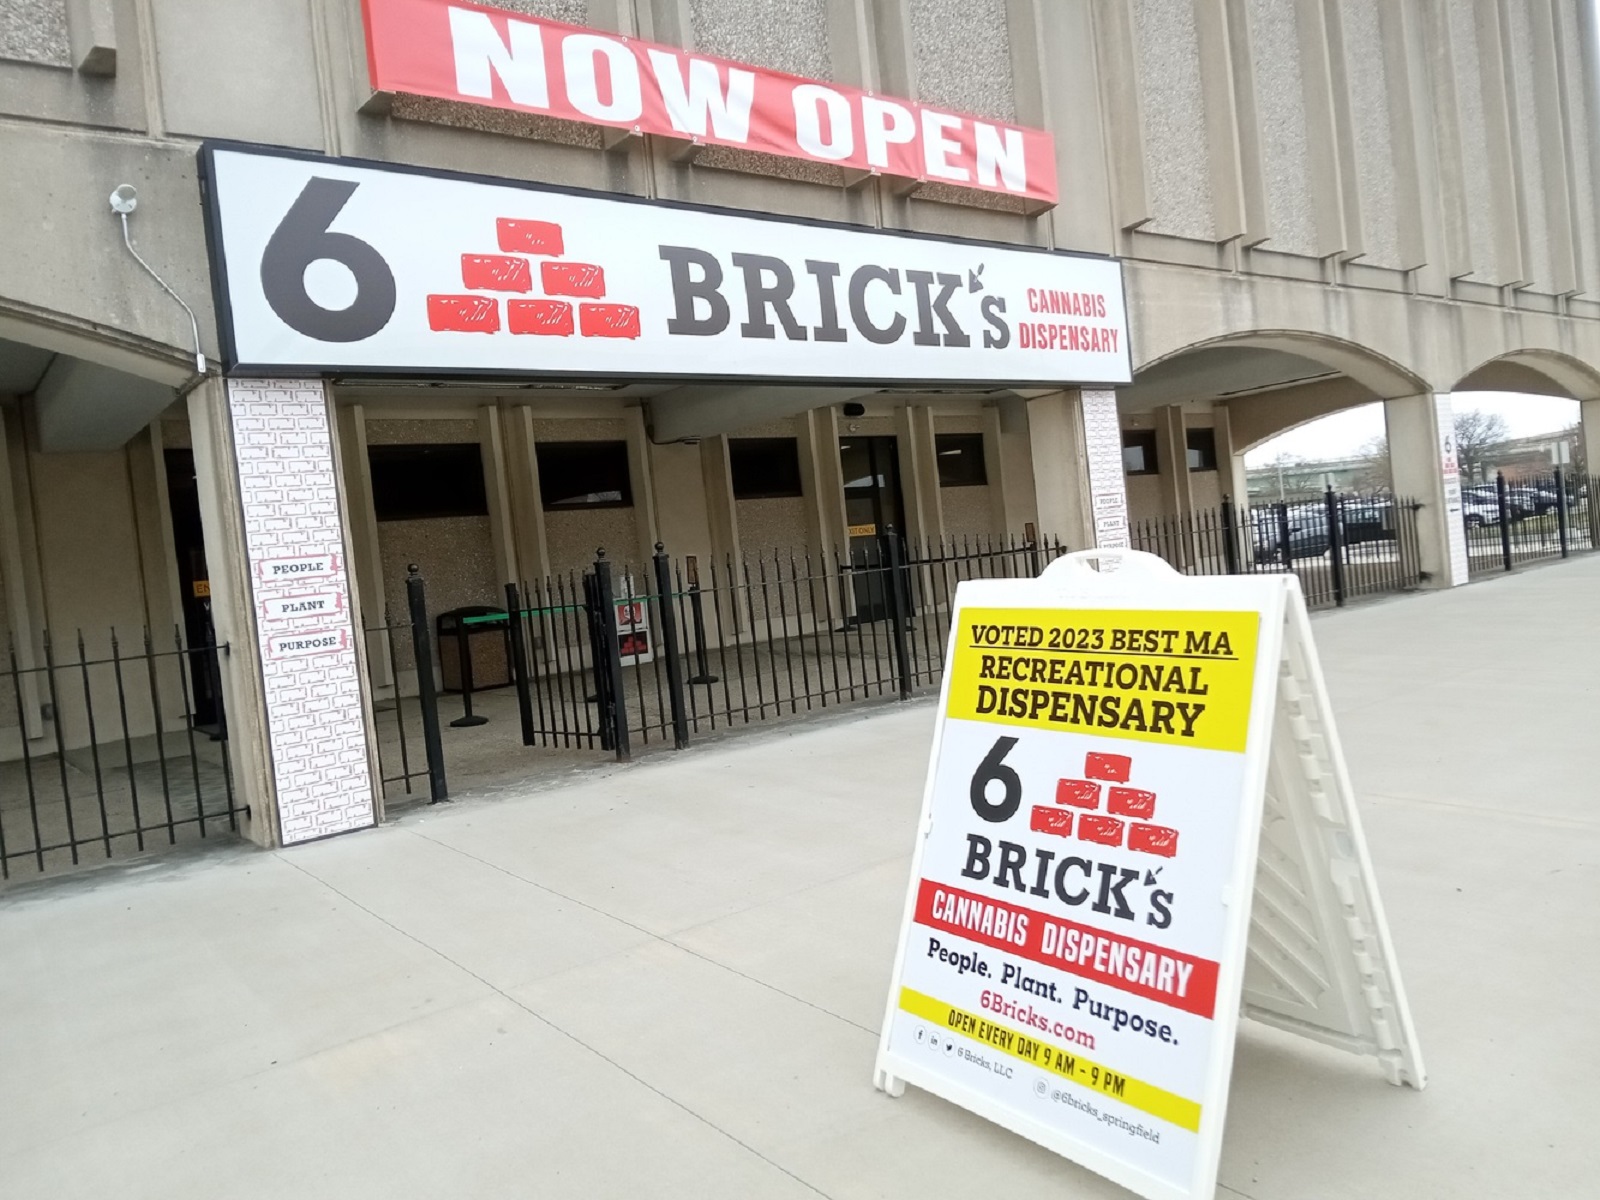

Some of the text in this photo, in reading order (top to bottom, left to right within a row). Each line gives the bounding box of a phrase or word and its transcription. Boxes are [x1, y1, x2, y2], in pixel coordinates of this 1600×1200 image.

[448, 6, 1027, 193] NOW OPEN
[261, 177, 396, 342] 6
[1027, 288, 1107, 318] CANNABIS
[1019, 322, 1119, 354] DISPENSARY
[273, 562, 324, 575] PEOPLE
[281, 600, 325, 613] PLANT
[279, 636, 337, 652] PURPOSE
[971, 624, 1234, 656] VOTED 2023 BEST MA
[979, 655, 1209, 696] RECREATIONAL
[975, 685, 1206, 738] DISPENSARY
[970, 735, 1022, 823] 6
[931, 889, 1195, 998] CANNABIS DISPENSARY
[927, 937, 1180, 1046] People. Plant. Purpose.
[980, 989, 1096, 1051] 6Bricks.com
[948, 1009, 976, 1034] OPEN
[978, 1023, 1014, 1051] EVERY
[1016, 1036, 1041, 1062] DAY
[1043, 1047, 1052, 1065] 9
[1054, 1052, 1075, 1077] AM
[1091, 1066, 1099, 1086] 9
[1103, 1071, 1126, 1098] PM
[957, 1046, 964, 1057] 6
[964, 1047, 991, 1072] Bricks,
[993, 1061, 1014, 1080] LLC
[1051, 1089, 1161, 1145] @6bricks_springfield
